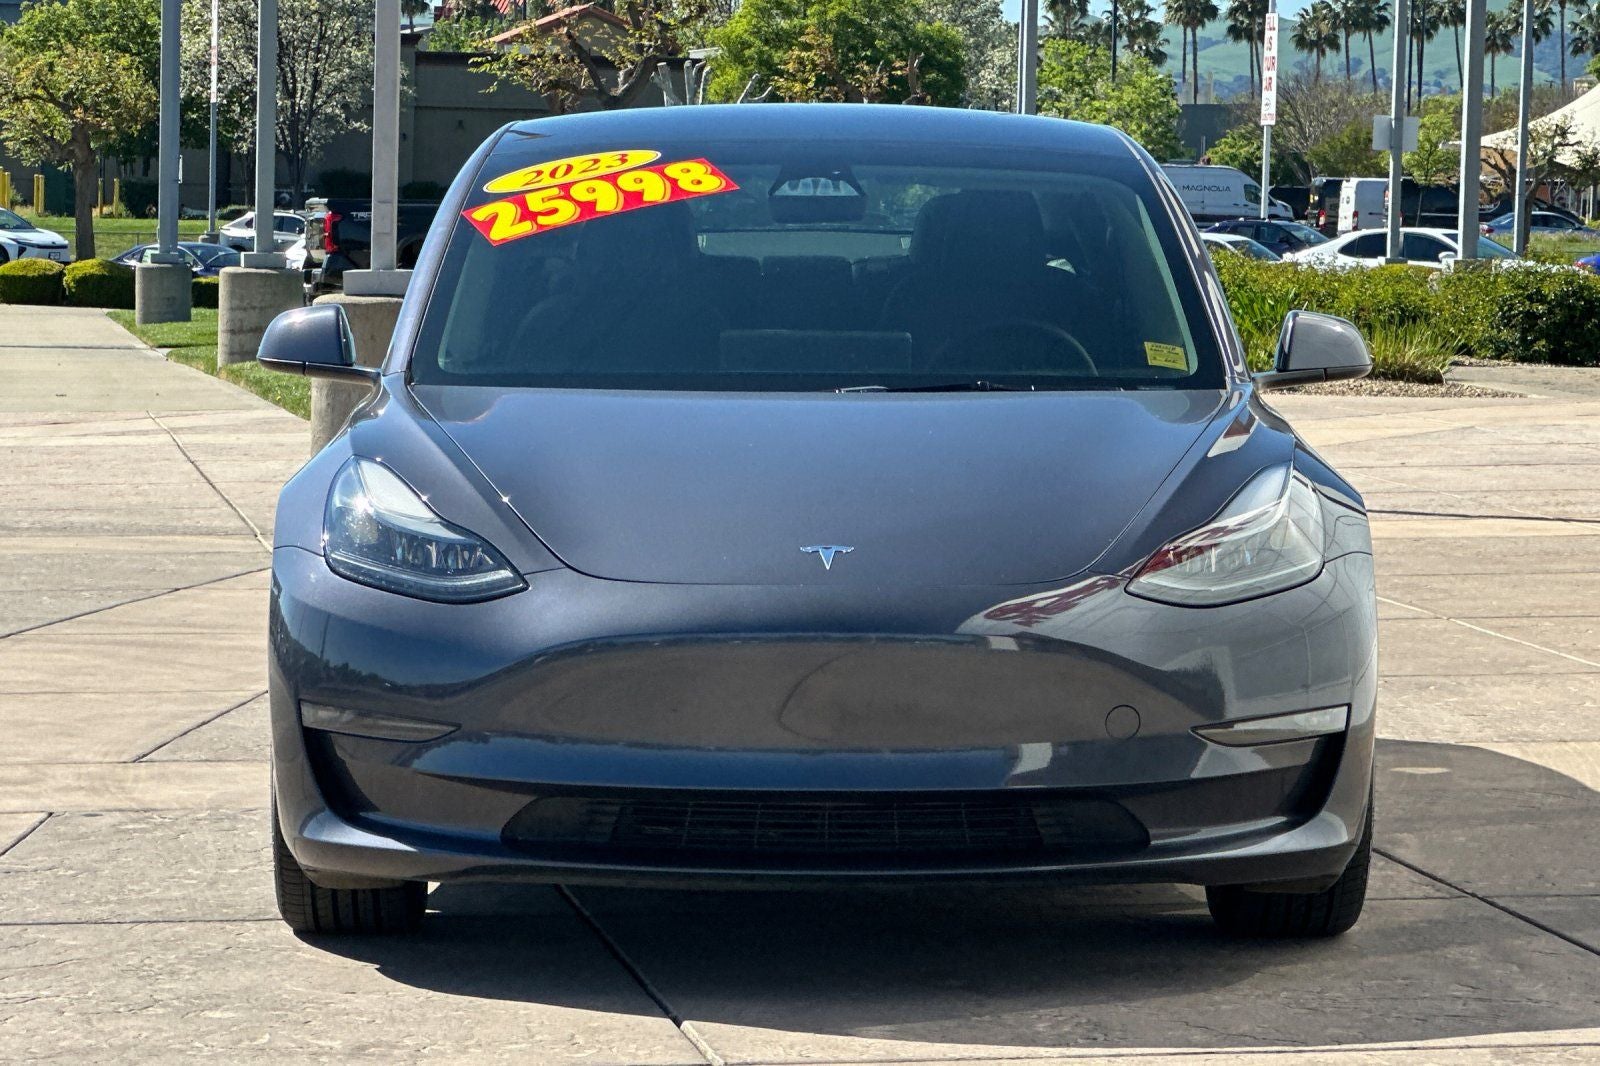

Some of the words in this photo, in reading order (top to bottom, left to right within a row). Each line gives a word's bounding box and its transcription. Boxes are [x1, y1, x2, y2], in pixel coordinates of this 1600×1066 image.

[521, 152, 629, 188] 2023
[1182, 184, 1232, 192] MAGNOLIA
[471, 160, 727, 241] 25998
